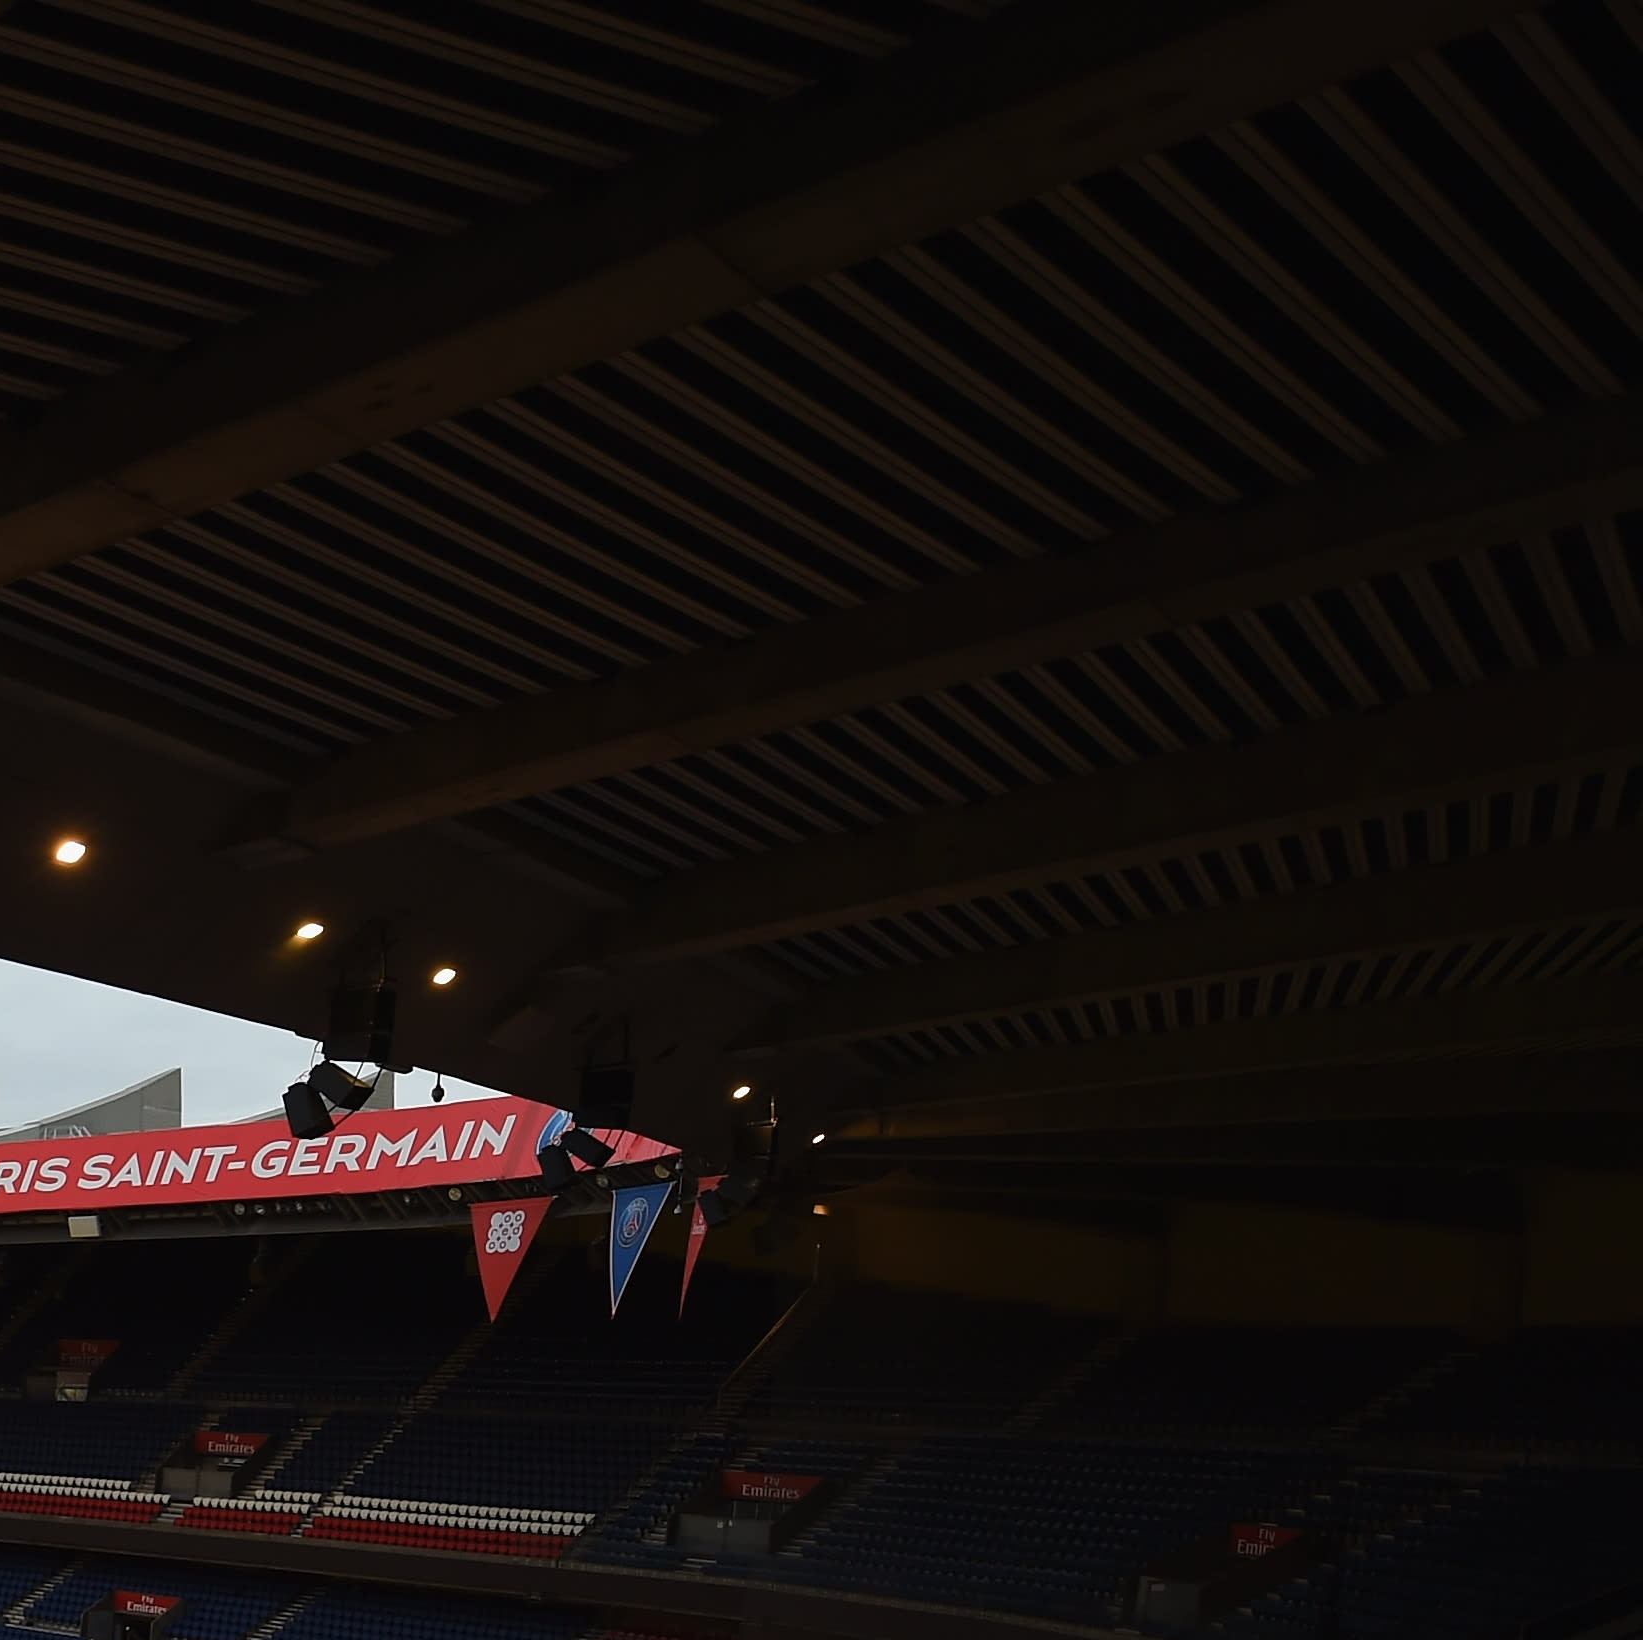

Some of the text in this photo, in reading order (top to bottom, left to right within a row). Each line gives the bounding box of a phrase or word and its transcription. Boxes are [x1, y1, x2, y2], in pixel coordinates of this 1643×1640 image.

[77, 1114, 517, 1190] SAINT-GERMAIN
[208, 1441, 255, 1454] Emirates
[763, 1475, 780, 1486] Fly
[742, 1484, 800, 1499] Emirates
[1259, 1528, 1276, 1542] Fly
[1237, 1539, 1275, 1556] Emir
